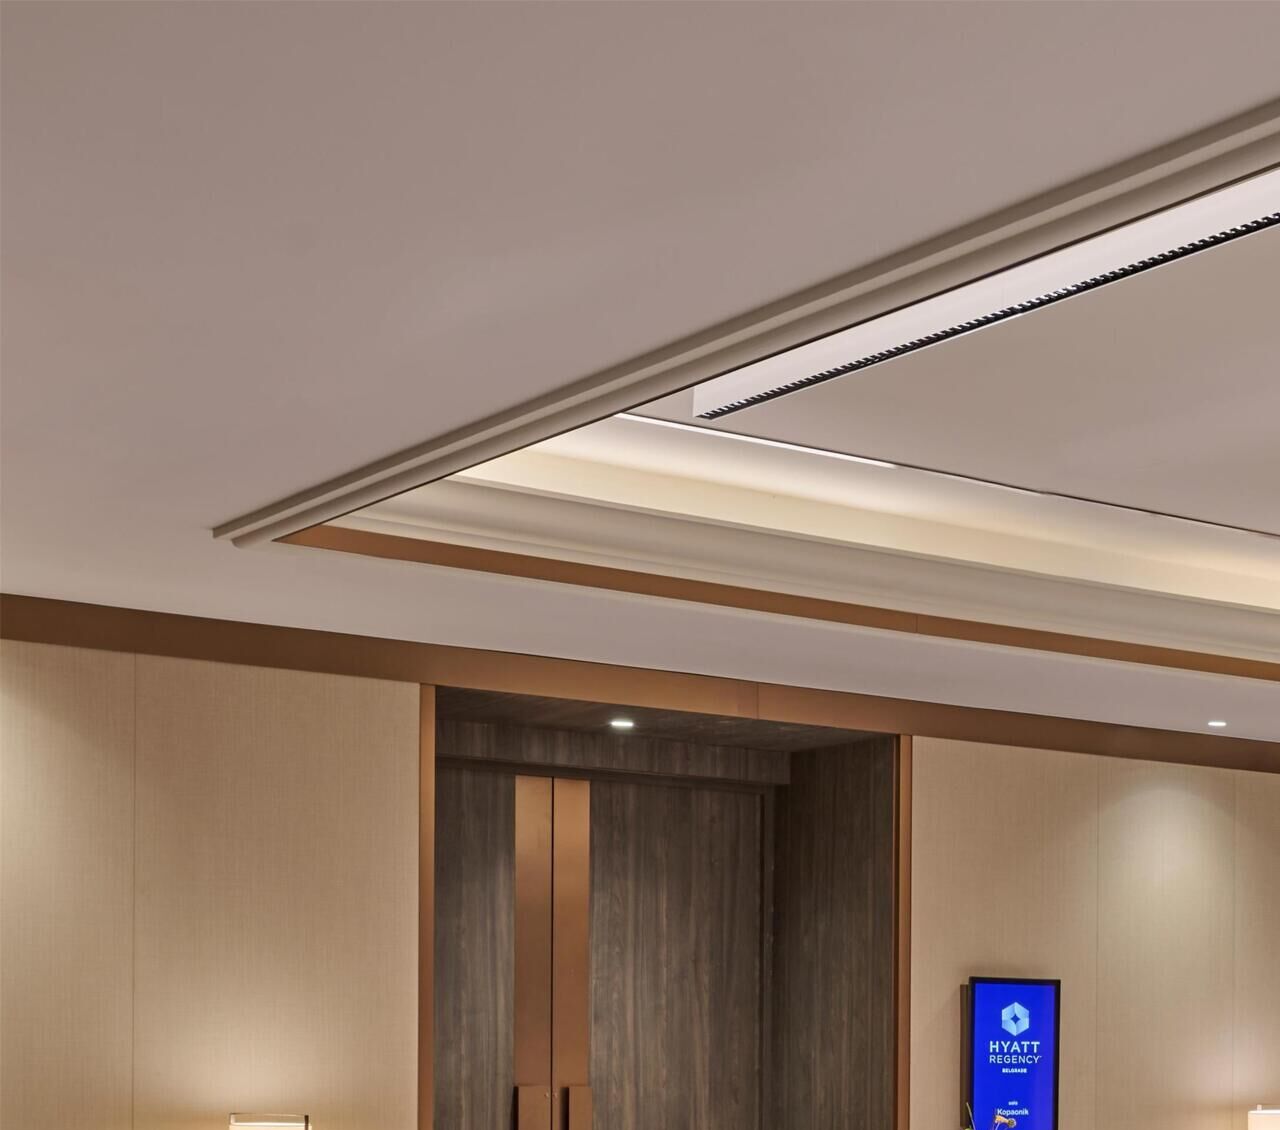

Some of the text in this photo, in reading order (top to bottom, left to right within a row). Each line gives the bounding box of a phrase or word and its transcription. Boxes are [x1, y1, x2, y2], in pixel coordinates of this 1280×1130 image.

[989, 1041, 1040, 1053] HYATT
[989, 1055, 1040, 1064] REGENCY
[997, 1108, 1029, 1116] Kopaonik
